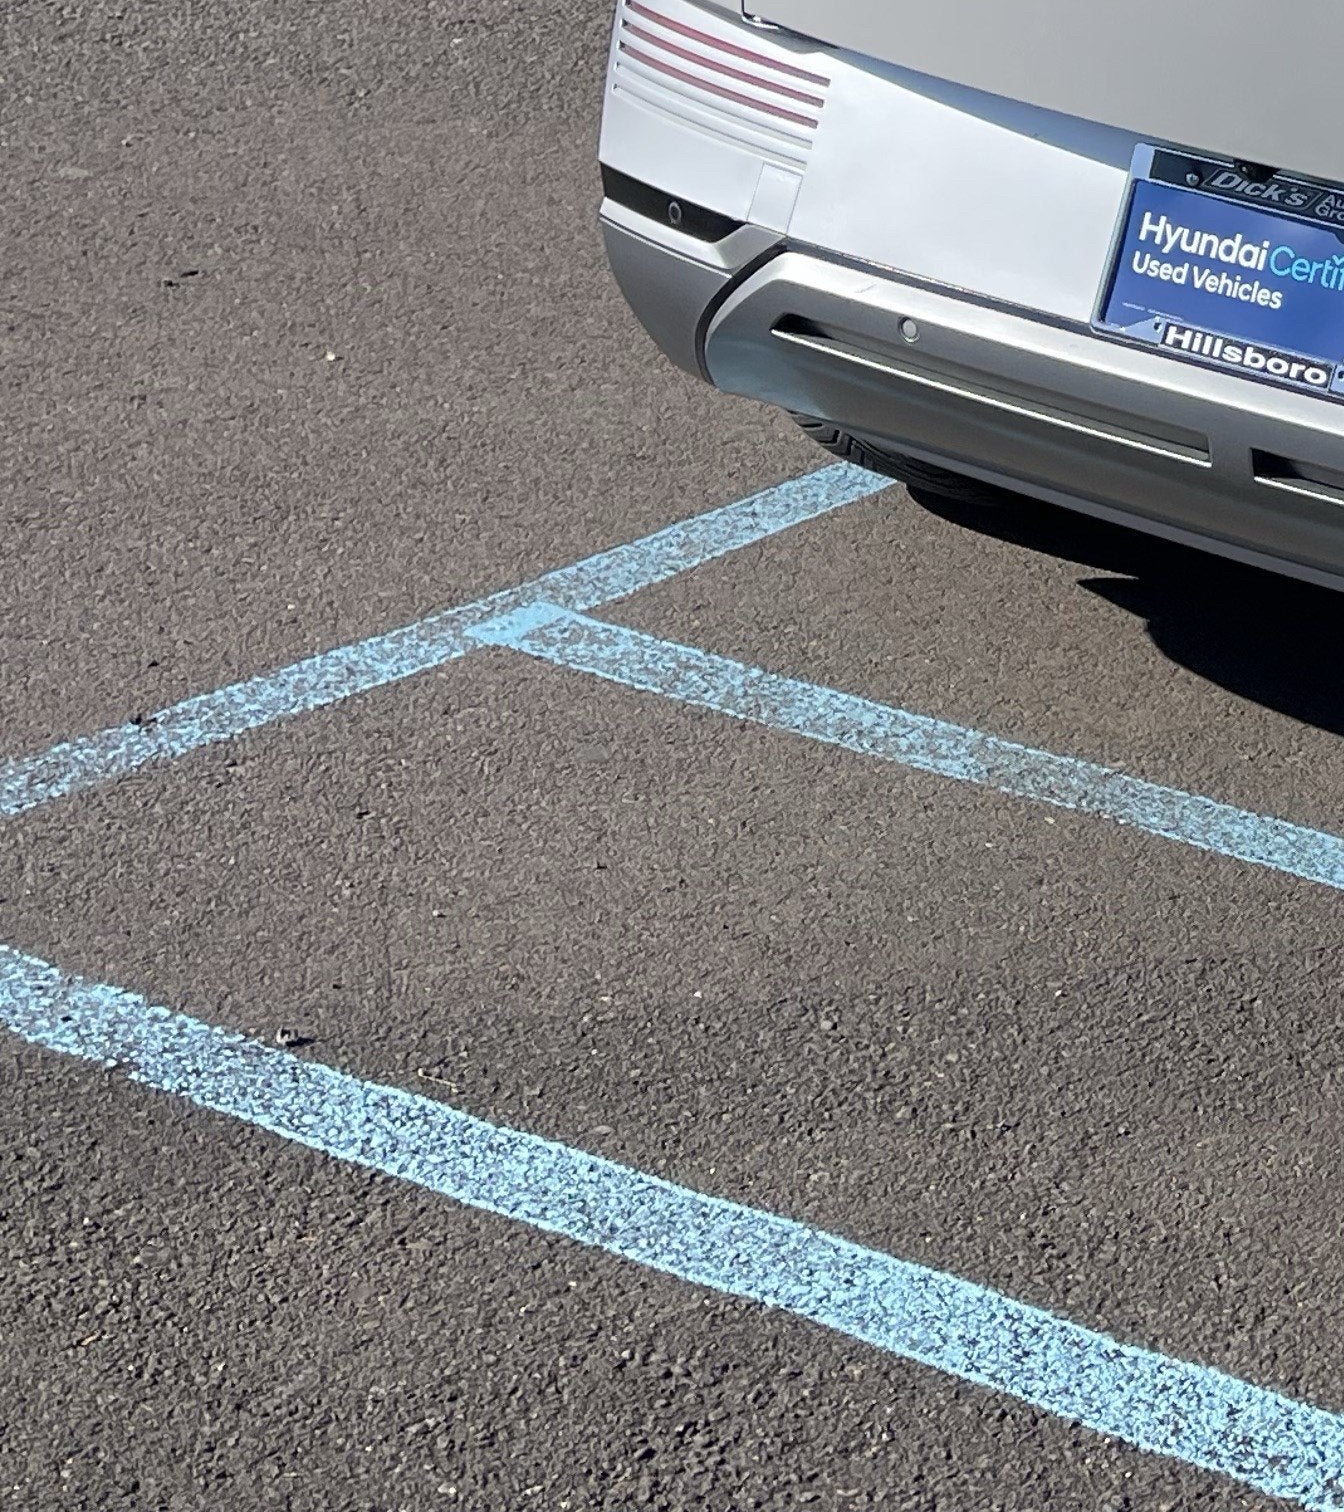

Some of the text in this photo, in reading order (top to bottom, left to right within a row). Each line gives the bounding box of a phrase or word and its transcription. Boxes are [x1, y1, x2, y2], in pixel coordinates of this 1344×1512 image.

[1210, 171, 1310, 207] Dick's
[1137, 211, 1270, 272] Hyundai
[1131, 251, 1284, 310] Used Vehicles
[1164, 325, 1329, 386] Hillsboro
